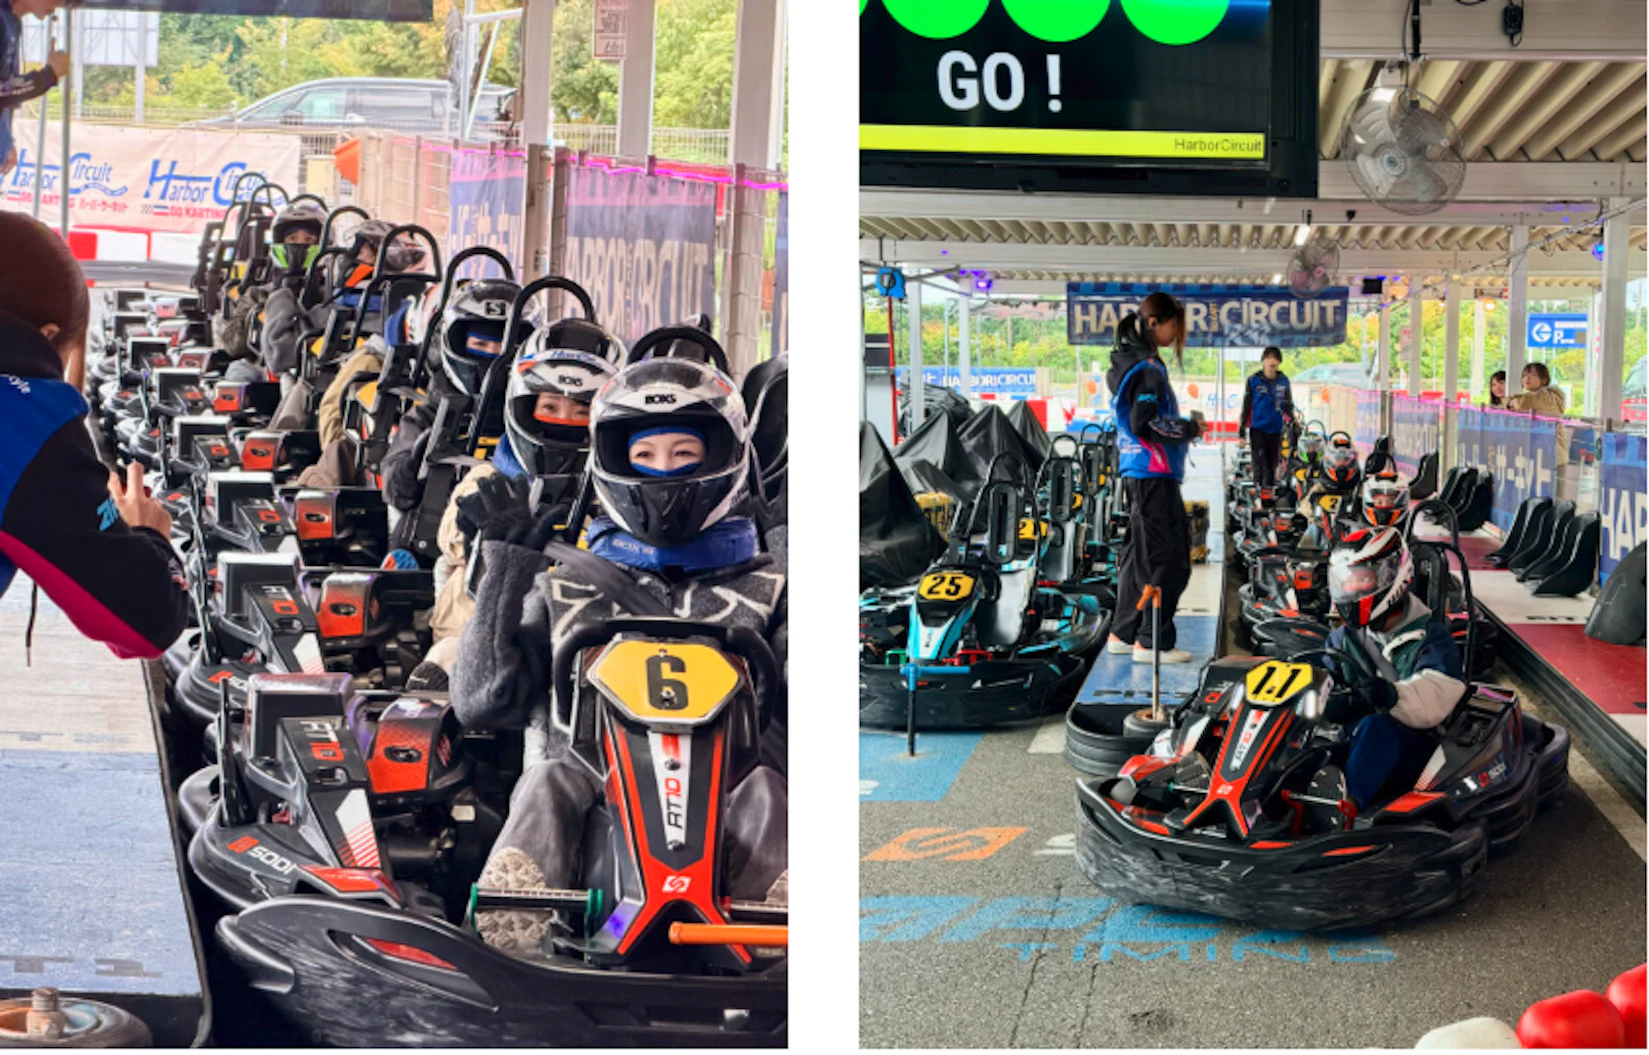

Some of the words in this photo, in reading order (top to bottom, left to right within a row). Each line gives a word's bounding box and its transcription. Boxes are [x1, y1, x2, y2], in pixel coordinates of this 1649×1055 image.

[937, 50, 1025, 111] GO
[1174, 138, 1263, 154] HarborCircuit
[143, 159, 213, 203] Harbor
[1219, 299, 1341, 331] CIRCUIT
[927, 574, 964, 596] 25
[645, 653, 690, 711] 6
[665, 777, 683, 829] RT10
[247, 845, 297, 876] SODI
[1001, 942, 1398, 963] TIMING
